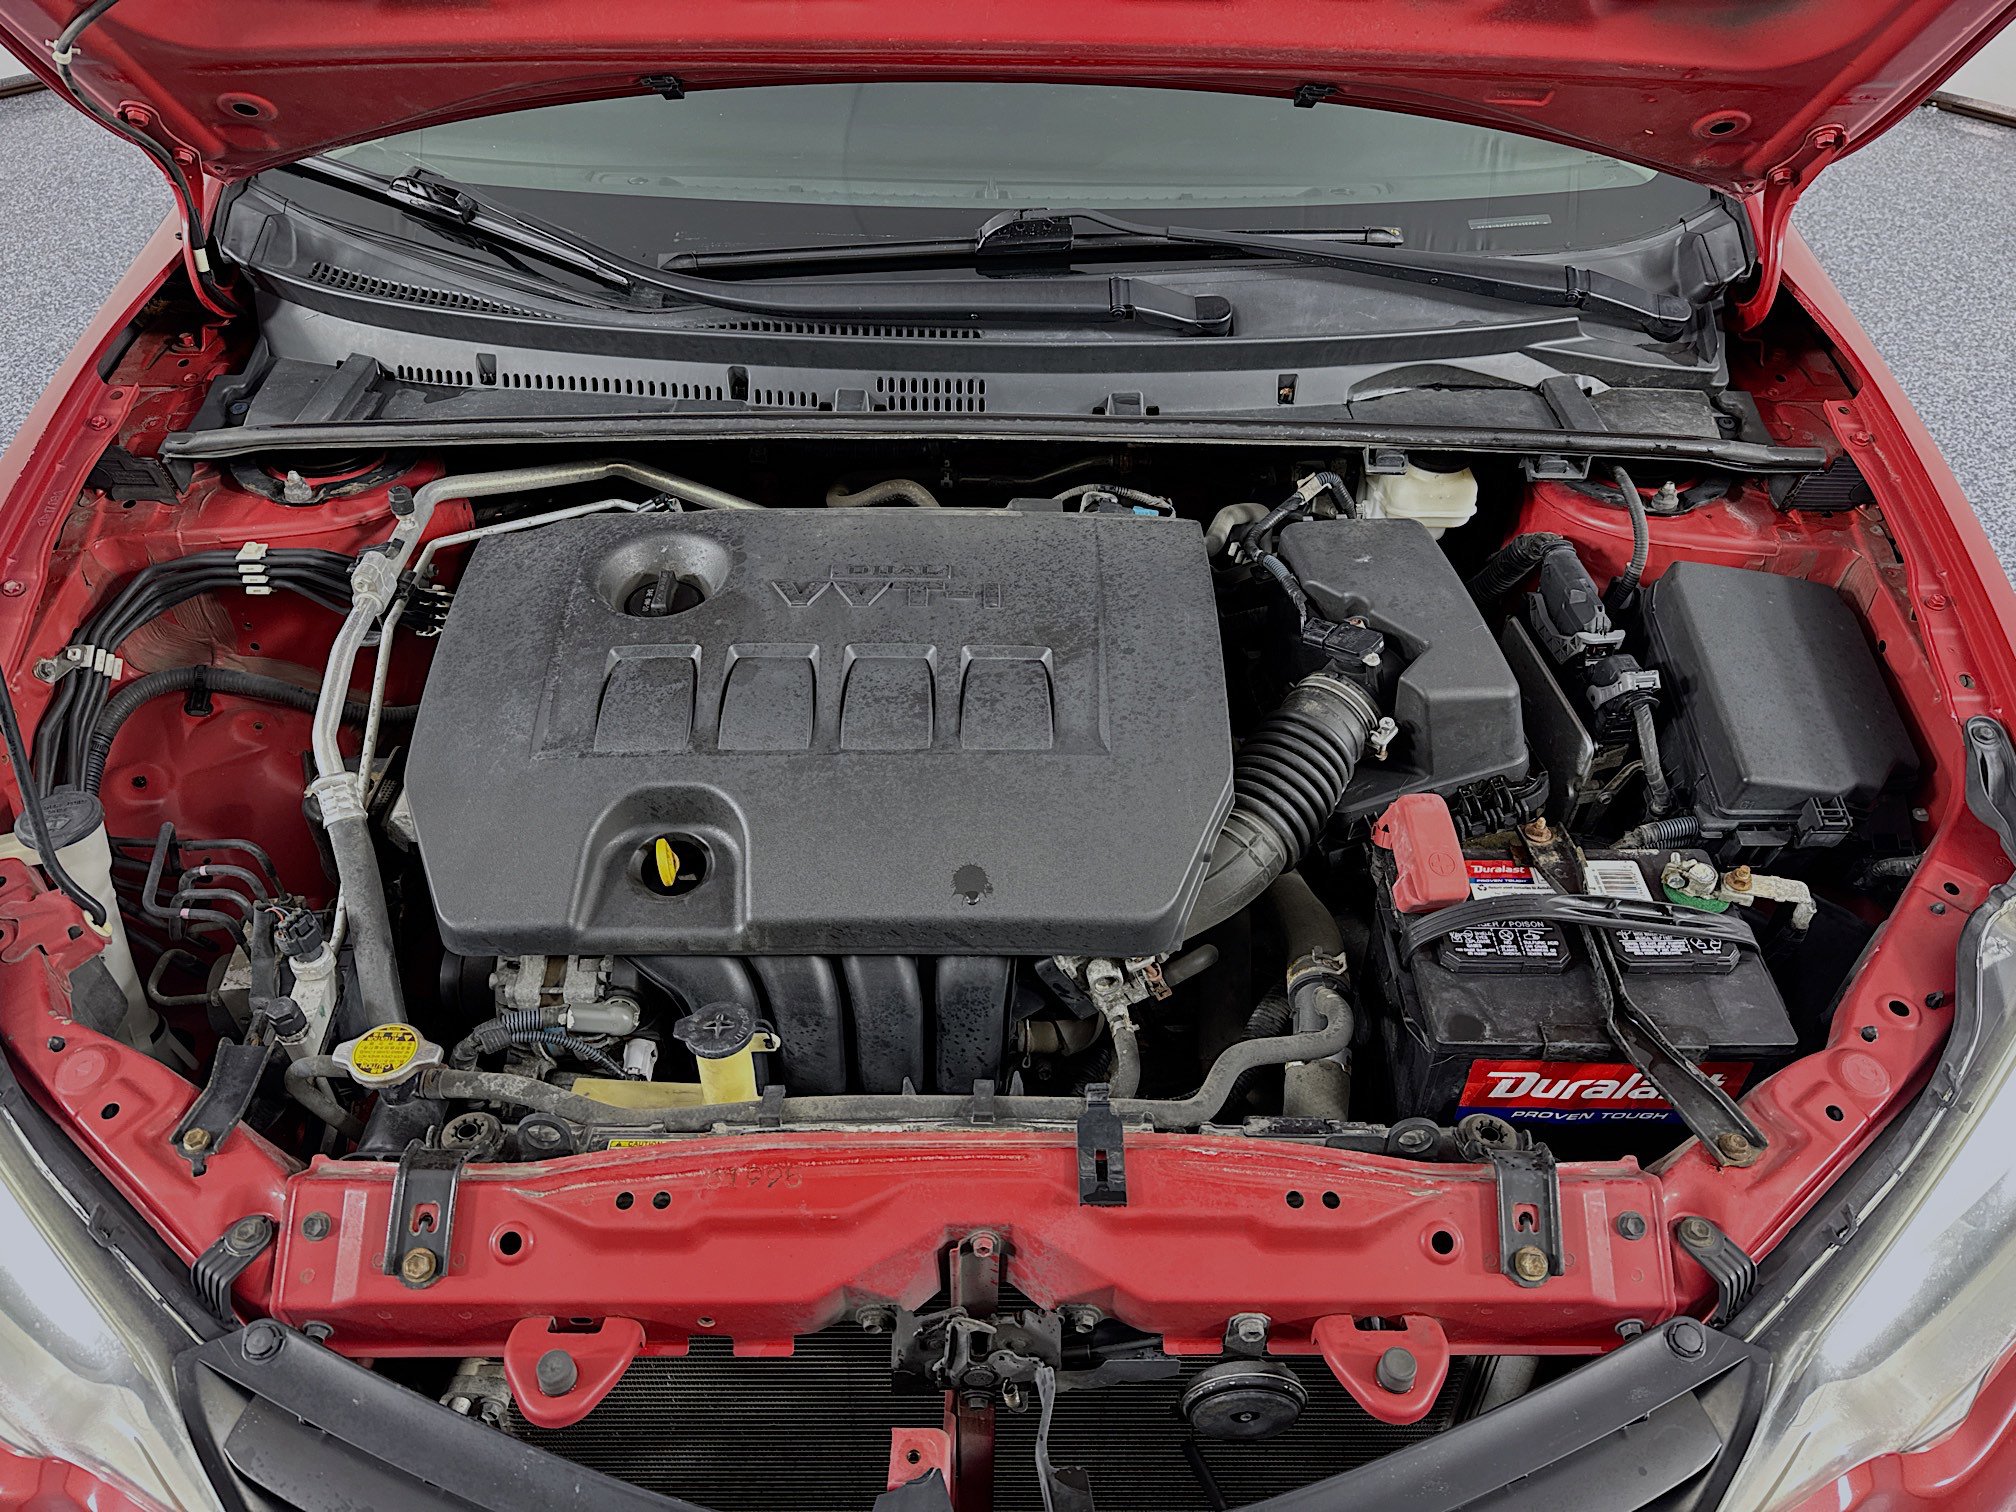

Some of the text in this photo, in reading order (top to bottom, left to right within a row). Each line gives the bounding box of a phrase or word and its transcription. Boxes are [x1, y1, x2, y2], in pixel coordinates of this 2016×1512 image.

[1470, 865, 1526, 874] Duralast
[1487, 1071, 1728, 1100] Duralat
[1511, 1111, 1670, 1121] PROVEN TOUGH
